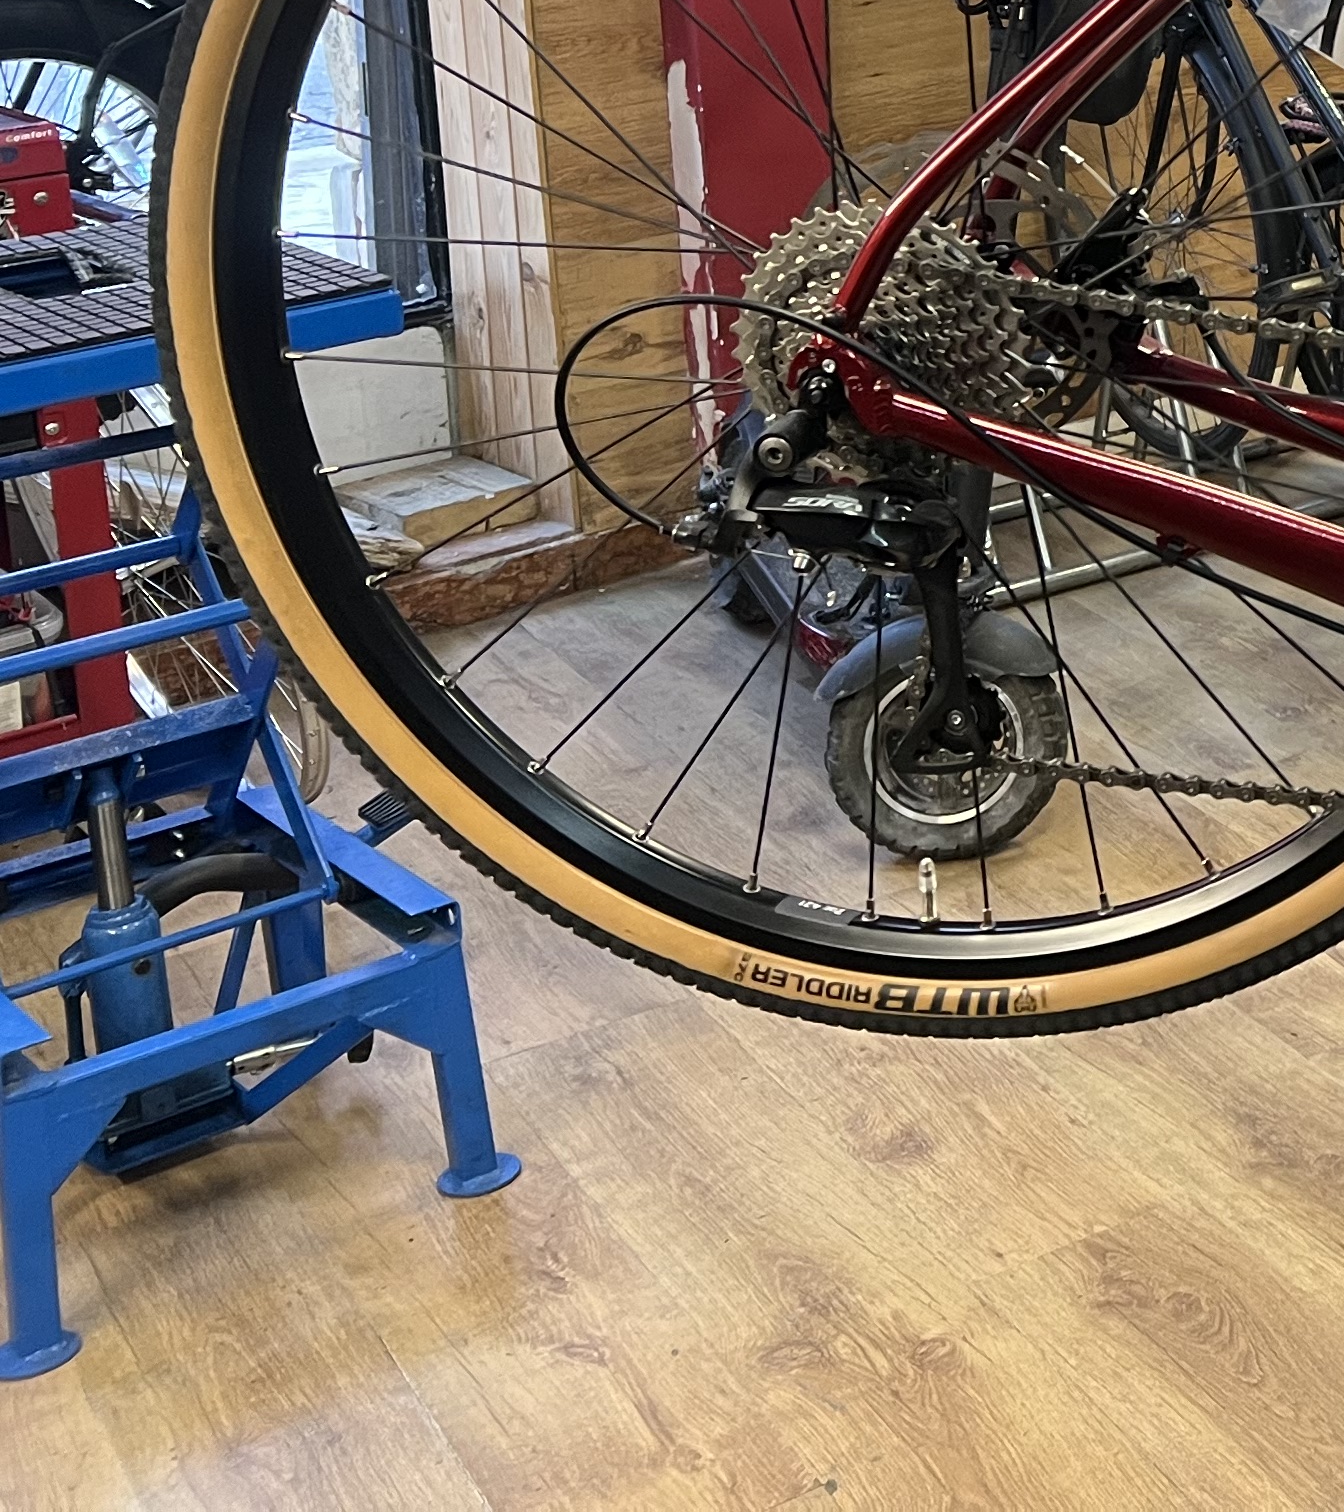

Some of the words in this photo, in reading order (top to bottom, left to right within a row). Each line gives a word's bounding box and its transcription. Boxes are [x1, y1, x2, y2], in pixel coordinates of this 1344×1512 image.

[5, 128, 53, 144] Comfort
[749, 961, 873, 1007] RIDDLER
[872, 984, 1011, 1017] WTB
